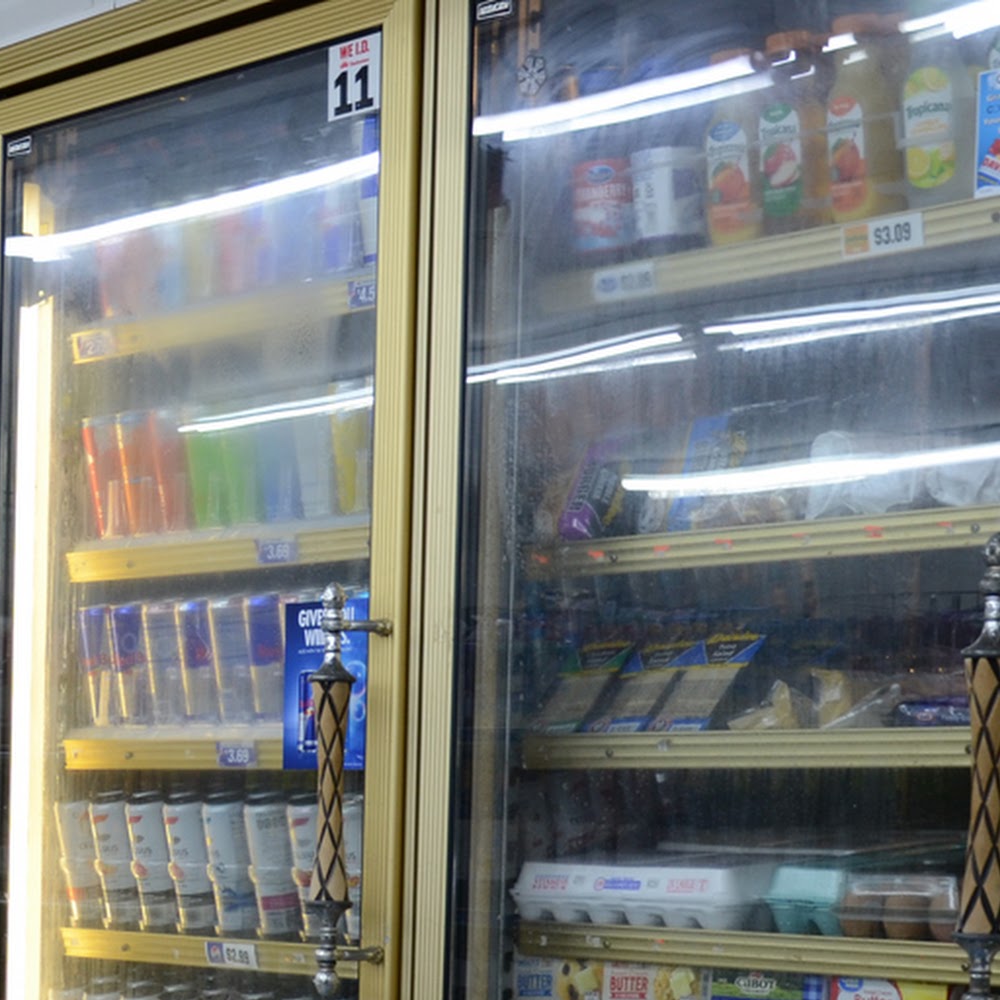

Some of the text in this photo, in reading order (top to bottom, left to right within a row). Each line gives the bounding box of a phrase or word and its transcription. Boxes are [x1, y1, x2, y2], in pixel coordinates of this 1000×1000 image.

[340, 44, 353, 58] WE
[334, 65, 374, 116] 11
[873, 222, 911, 246] $3.09
[298, 609, 332, 627] GIVE
[610, 976, 648, 991] BUTTER
